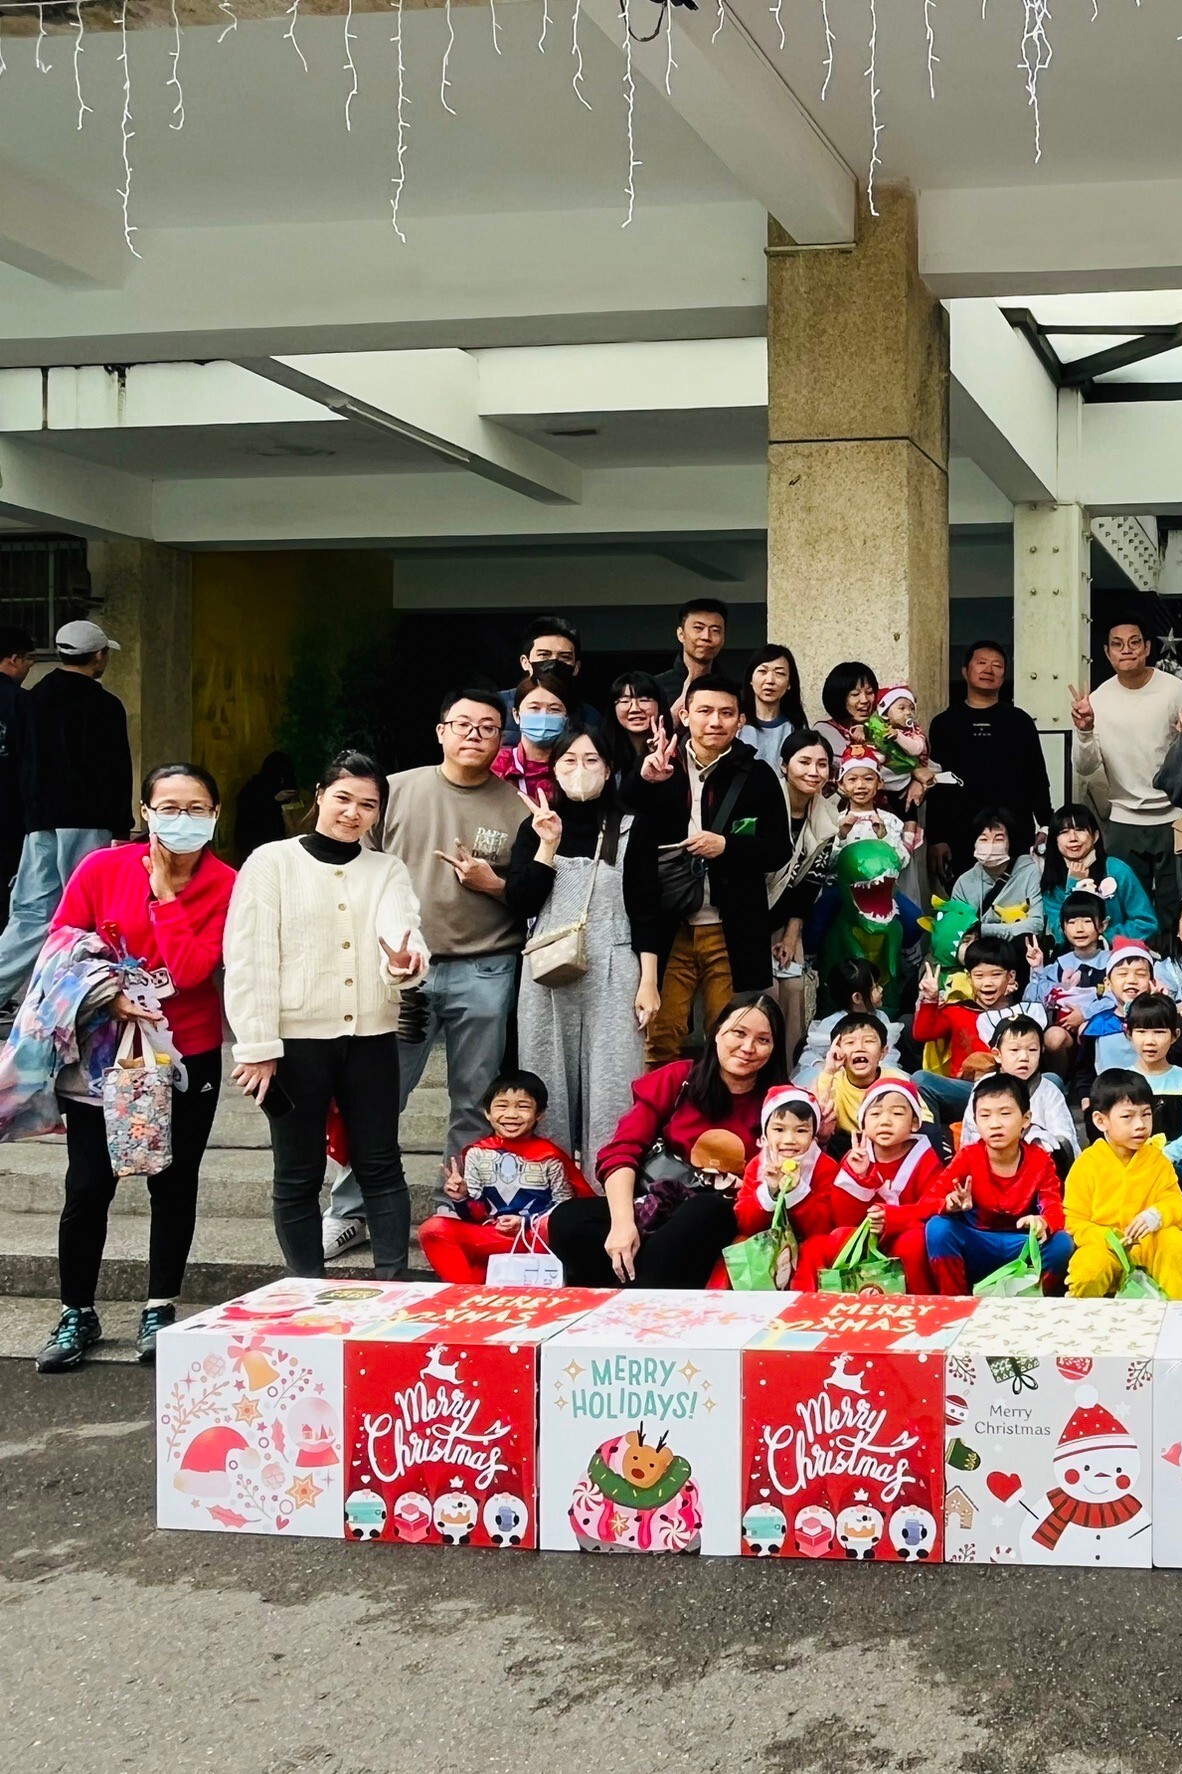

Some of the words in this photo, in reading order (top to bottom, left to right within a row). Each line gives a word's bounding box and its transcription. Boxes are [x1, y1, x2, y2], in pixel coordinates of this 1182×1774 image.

[458, 1293, 570, 1310] MERRY
[829, 1302, 936, 1318] MERRY
[444, 1307, 540, 1324] XMAS
[813, 1316, 918, 1333] XMAS
[591, 1354, 677, 1388] MERRY
[395, 1380, 481, 1434] Merry
[571, 1388, 698, 1421] HOLIDAYS!
[988, 1403, 1033, 1421] Merry
[797, 1391, 888, 1447] Merry
[974, 1420, 1052, 1438] Christmas
[364, 1413, 512, 1491] Christmas
[764, 1420, 919, 1502] Christmas
